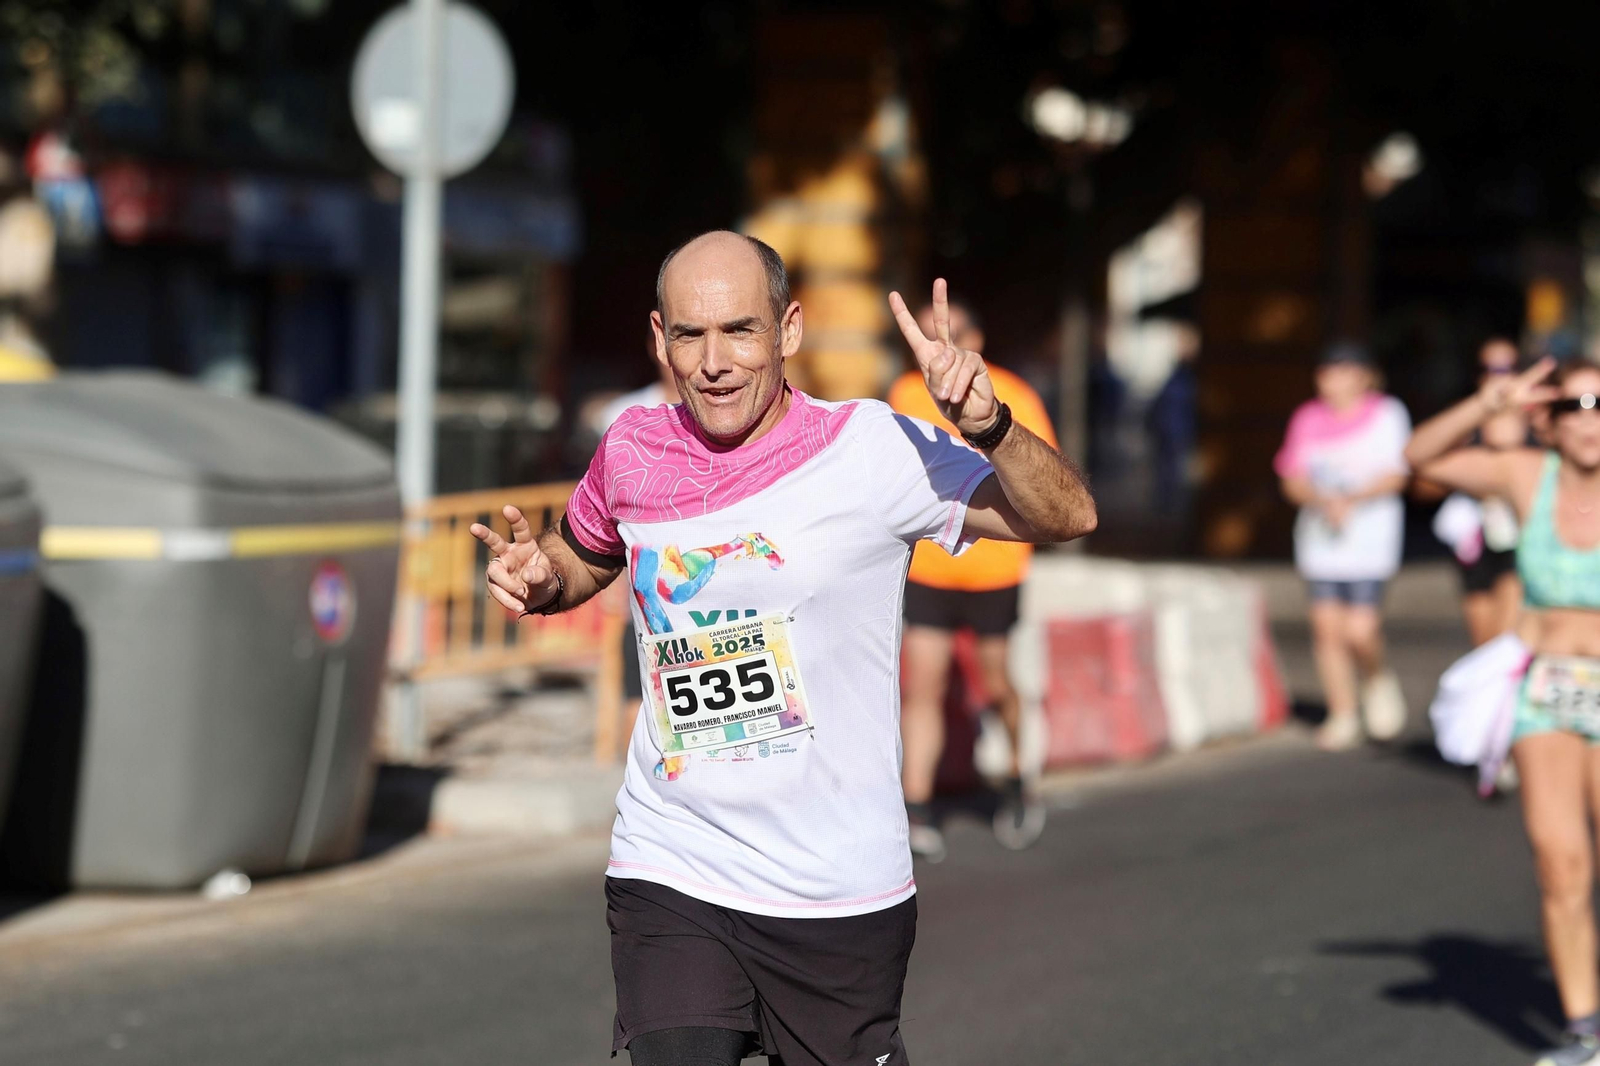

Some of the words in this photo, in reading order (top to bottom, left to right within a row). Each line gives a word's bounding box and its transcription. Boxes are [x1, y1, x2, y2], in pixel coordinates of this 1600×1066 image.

[709, 627, 737, 638] CARRERA
[738, 621, 764, 632] URBANA
[719, 633, 740, 642] TORCAL
[655, 637, 689, 667] XII
[678, 647, 705, 664] 10k
[712, 633, 766, 657] 2025
[666, 658, 775, 717] 535
[673, 721, 698, 732] NAVARRO
[697, 716, 723, 728] ROMERO,
[723, 709, 757, 723] FRANCISCO
[756, 703, 783, 716] MANUEL
